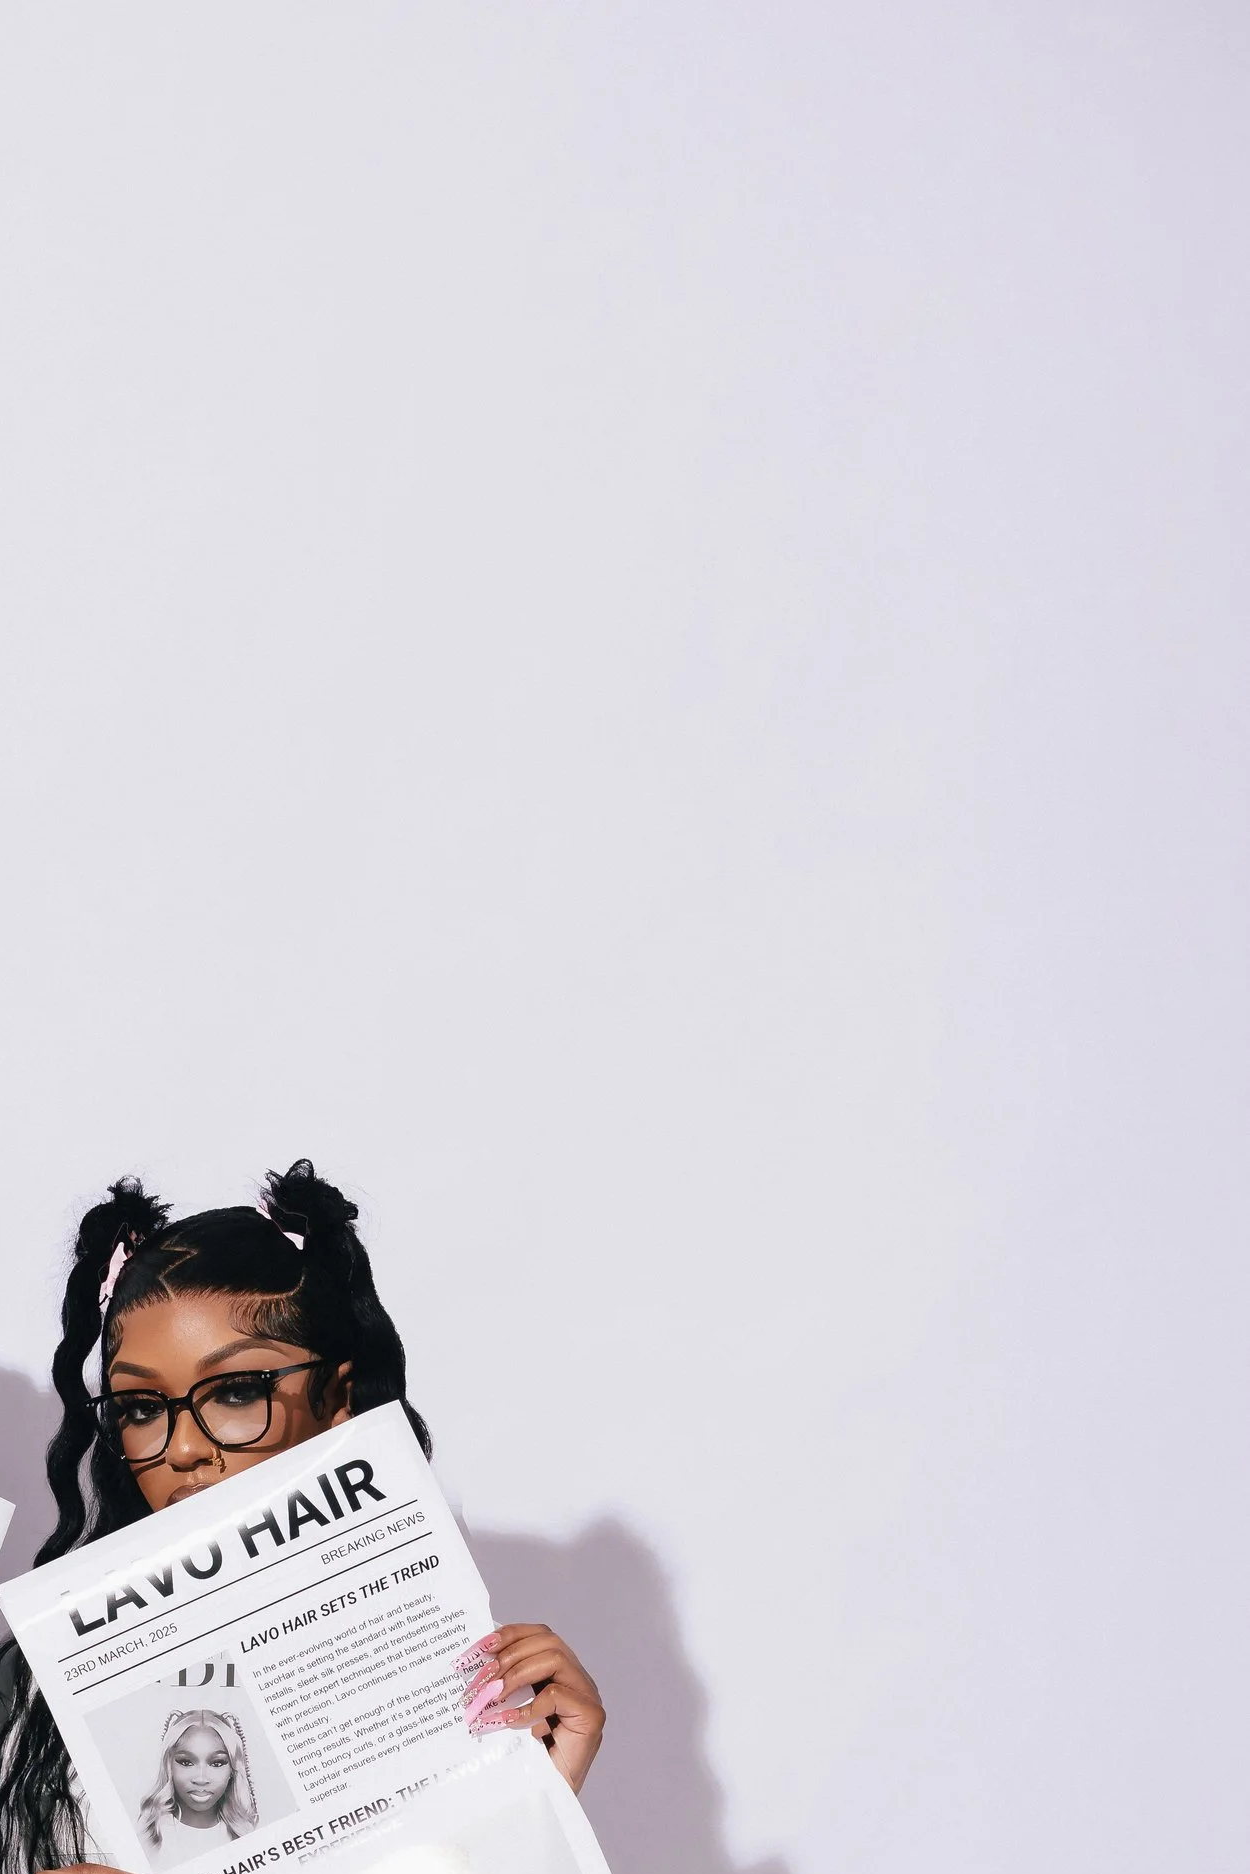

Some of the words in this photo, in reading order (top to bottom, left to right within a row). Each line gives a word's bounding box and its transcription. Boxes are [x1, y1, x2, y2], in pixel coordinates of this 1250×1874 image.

[237, 1459, 387, 1559] HAIR
[320, 1529, 386, 1565] BREAKING
[386, 1511, 425, 1535] NEWS
[240, 1627, 279, 1654] LAVO
[282, 1609, 318, 1635] HAIR
[320, 1591, 357, 1617] SETS
[358, 1576, 390, 1599] THE
[390, 1555, 439, 1584] TREND
[64, 1660, 96, 1682] 23RD
[97, 1637, 148, 1666] MARCH,
[148, 1622, 178, 1643] 2025
[252, 1670, 262, 1679] In
[262, 1663, 277, 1674] the
[278, 1638, 334, 1667] ever-evolving
[333, 1625, 358, 1642] world
[358, 1620, 367, 1631] of
[367, 1614, 385, 1627] hair
[386, 1605, 403, 1619] and
[258, 1669, 296, 1691] LavoHair
[296, 1666, 306, 1674] is
[306, 1652, 335, 1670] setting
[334, 1646, 350, 1657] the
[350, 1627, 387, 1650] standard
[387, 1620, 406, 1632] with
[406, 1605, 441, 1624] flawless
[269, 1699, 299, 1716] Known
[299, 1692, 312, 1703] for
[313, 1679, 340, 1697] expert
[340, 1659, 386, 1685] techniques
[386, 1650, 404, 1663] that
[403, 1638, 428, 1656] blend
[429, 1623, 466, 1644] creativity
[296, 1674, 320, 1689] sleek
[320, 1667, 335, 1678] silk
[372, 1641, 390, 1655] and
[389, 1620, 440, 1647] trendsetting
[275, 1716, 294, 1728] with
[334, 1688, 357, 1702] Lavo
[357, 1669, 398, 1692] continues
[397, 1665, 408, 1673] to
[408, 1654, 432, 1669] make
[433, 1641, 461, 1657] waves
[461, 1636, 470, 1645] in
[281, 1731, 296, 1741] the
[281, 1825, 324, 1856] BEST
[328, 1797, 394, 1835] FRIEND:
